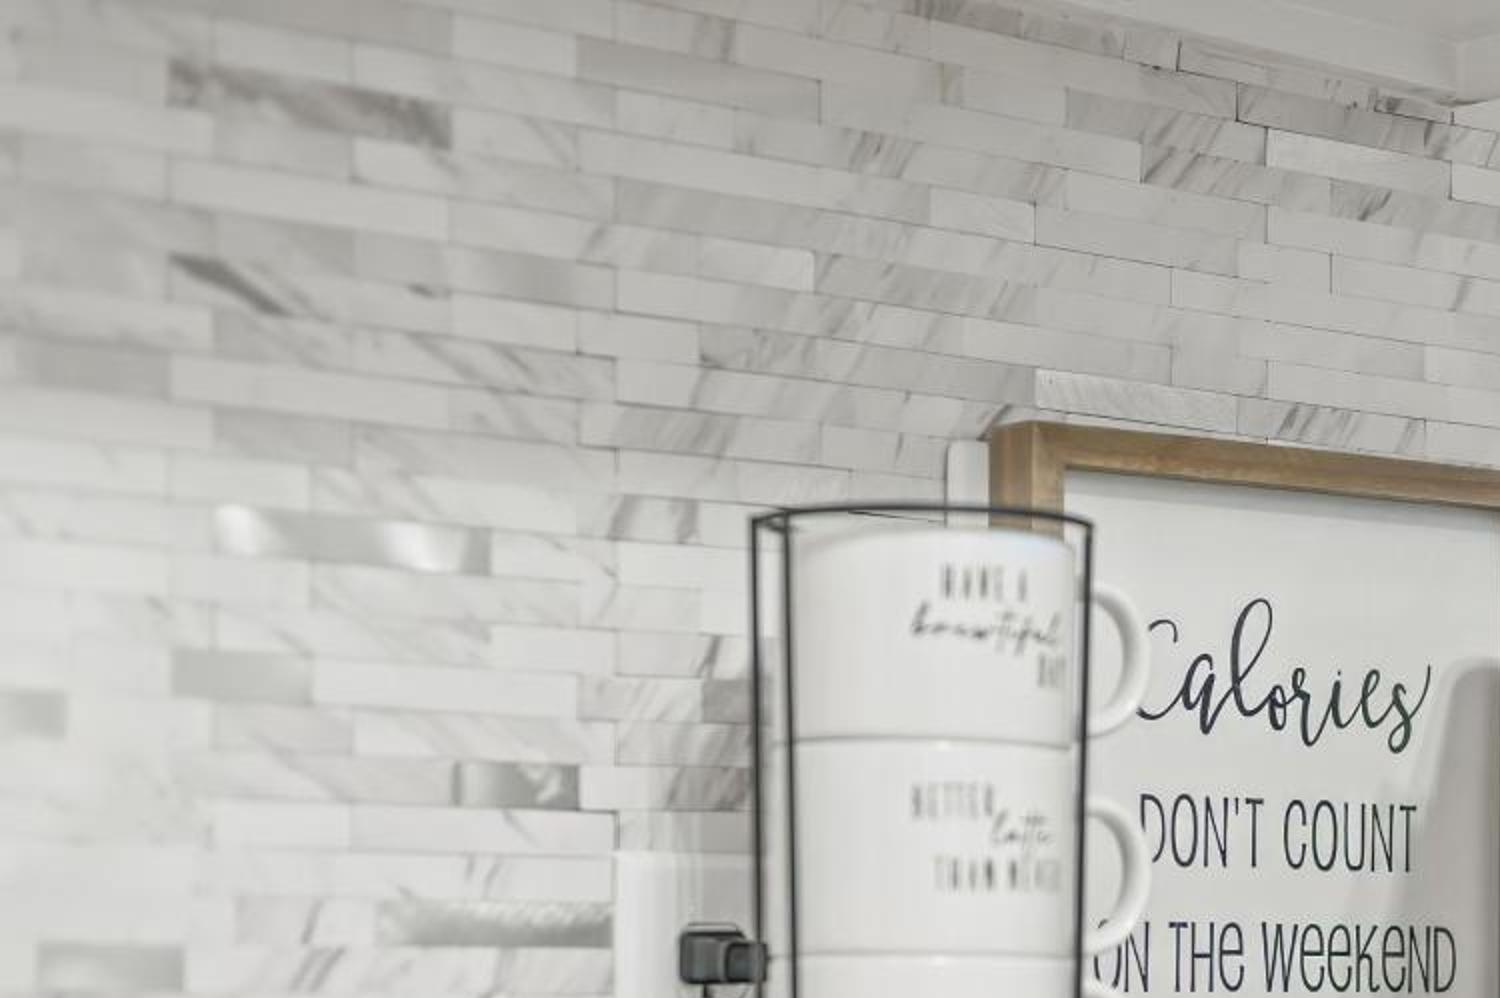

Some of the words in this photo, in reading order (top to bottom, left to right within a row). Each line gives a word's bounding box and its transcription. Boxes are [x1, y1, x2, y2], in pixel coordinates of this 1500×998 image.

[1137, 597, 1431, 754] Calories
[1140, 793, 1265, 868] DON'T
[1283, 799, 1418, 872] COUNT
